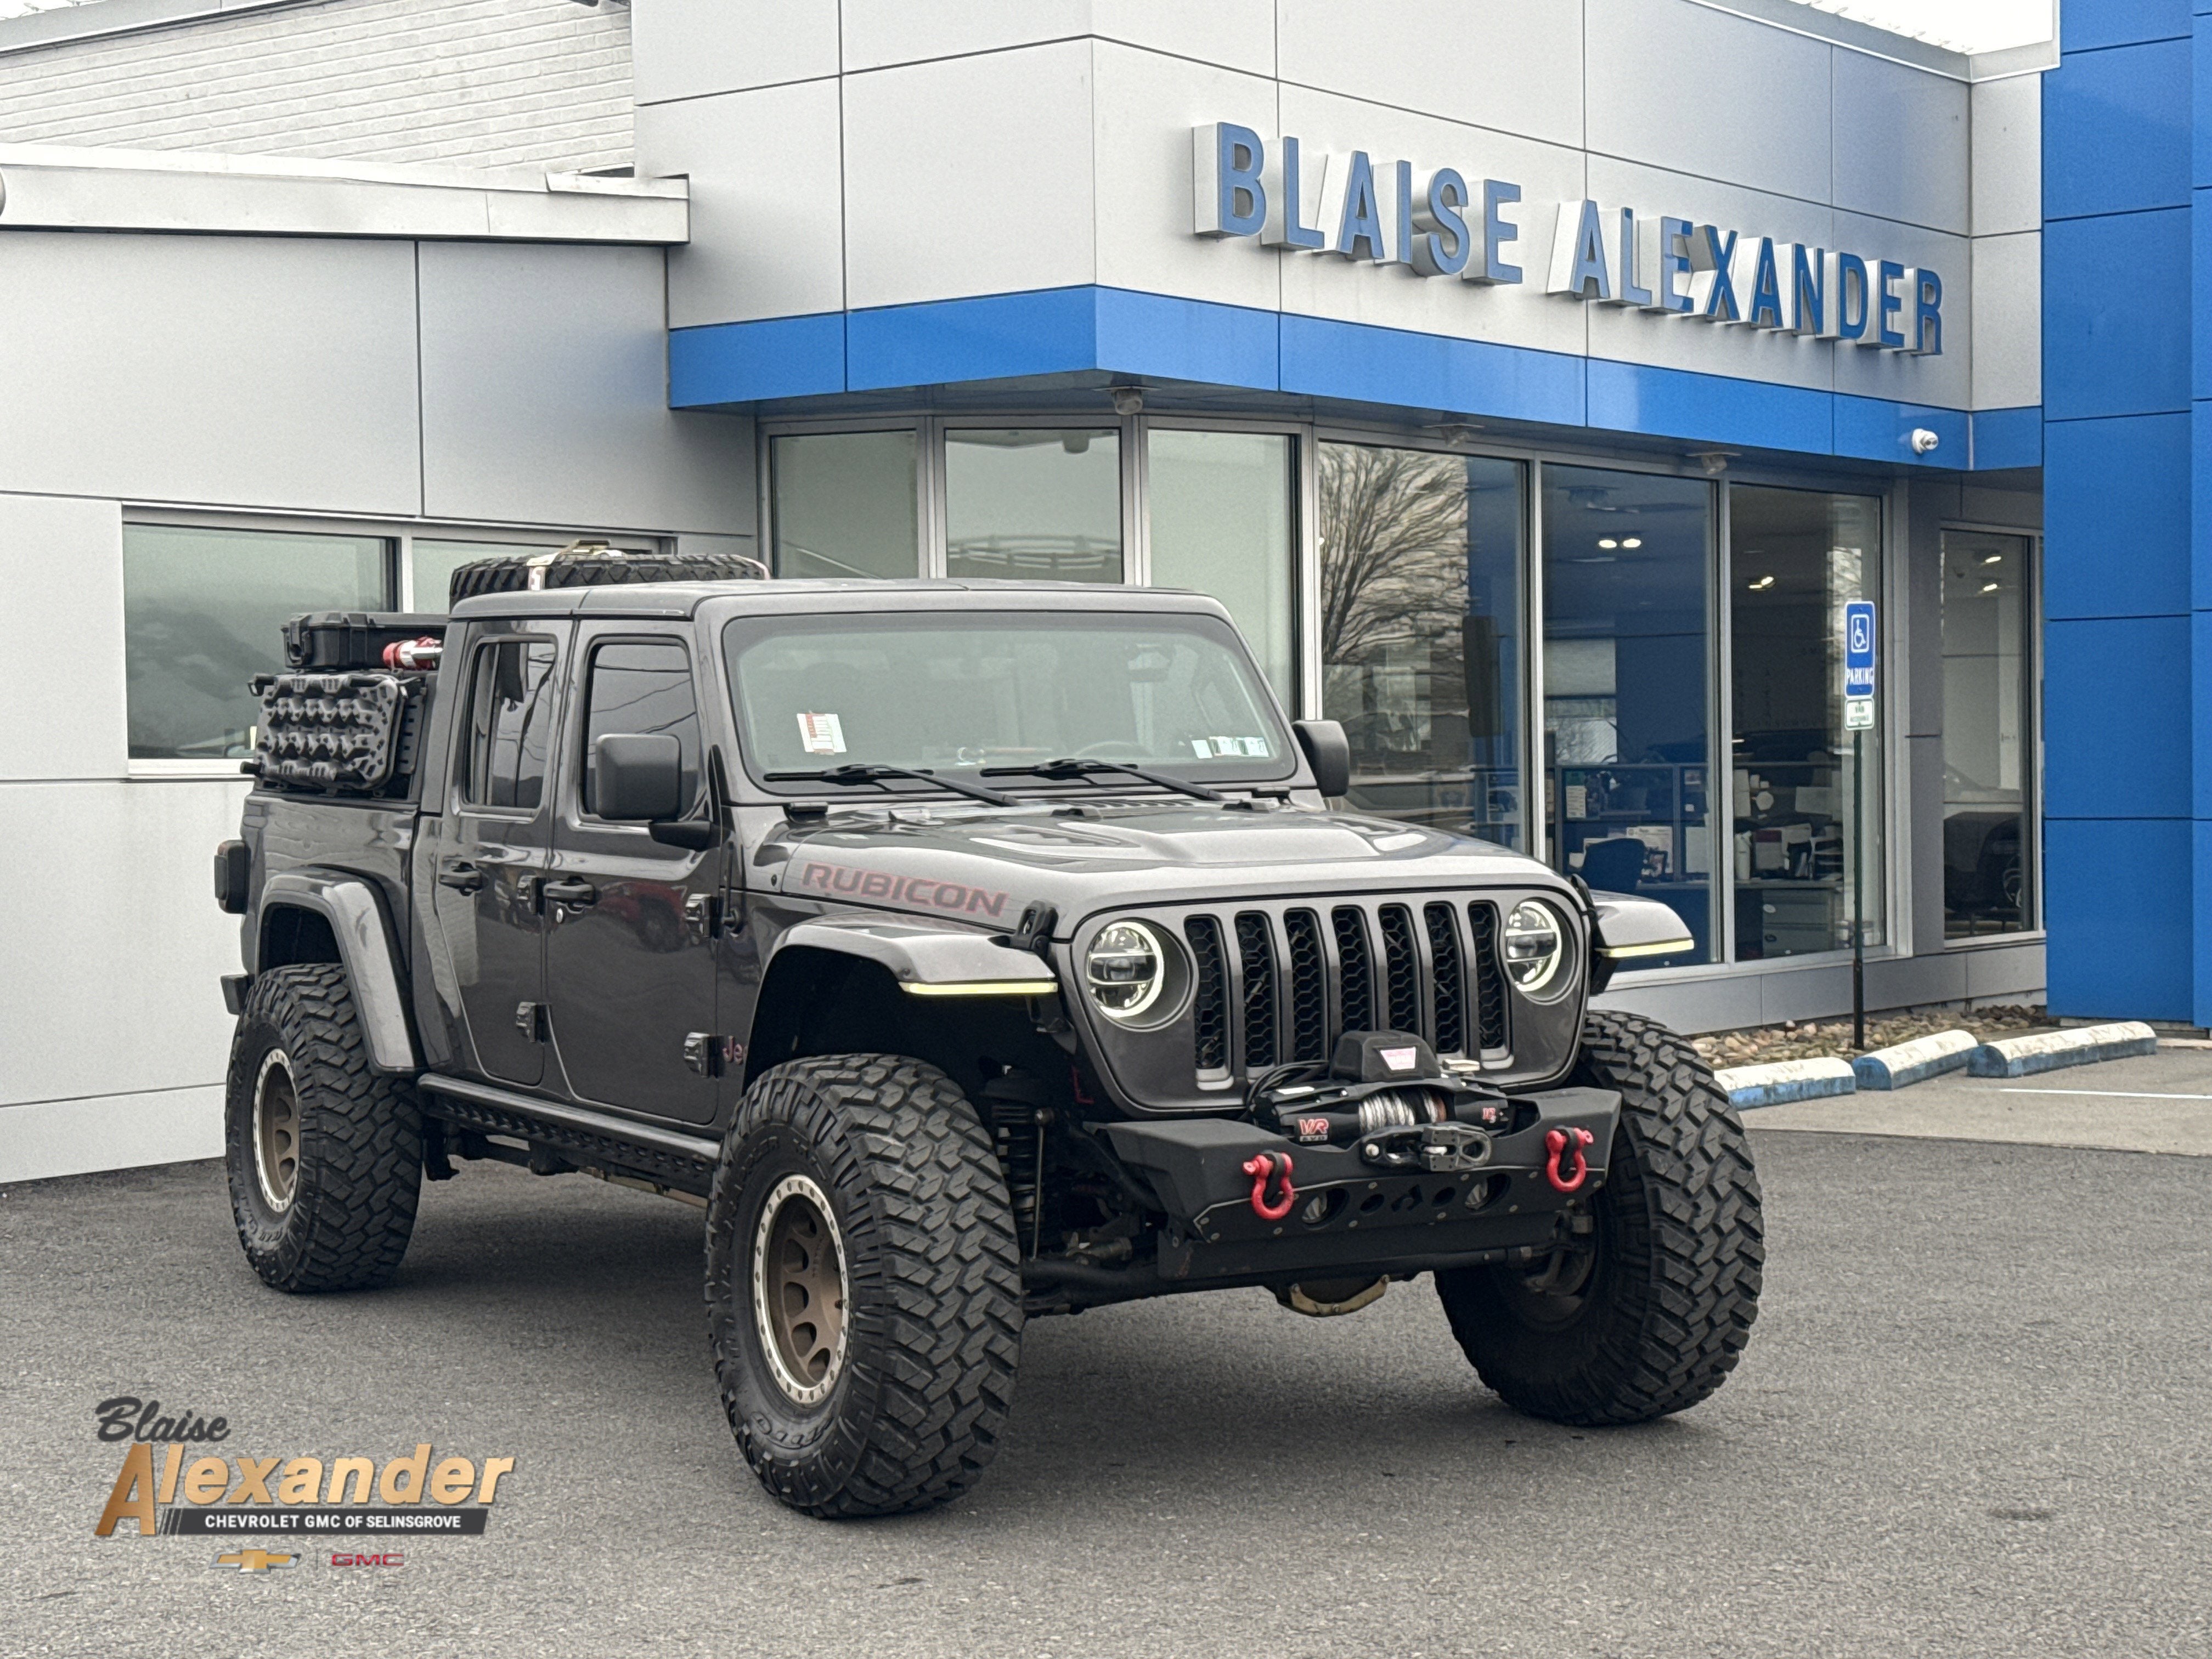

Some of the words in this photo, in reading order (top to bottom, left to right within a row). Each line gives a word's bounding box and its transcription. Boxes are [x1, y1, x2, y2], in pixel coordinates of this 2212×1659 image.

[1216, 121, 1523, 285] BLAISE
[1573, 199, 1943, 356] ALEXANDER
[1846, 667, 1874, 685] PARKING
[802, 862, 1009, 917] RUBICON
